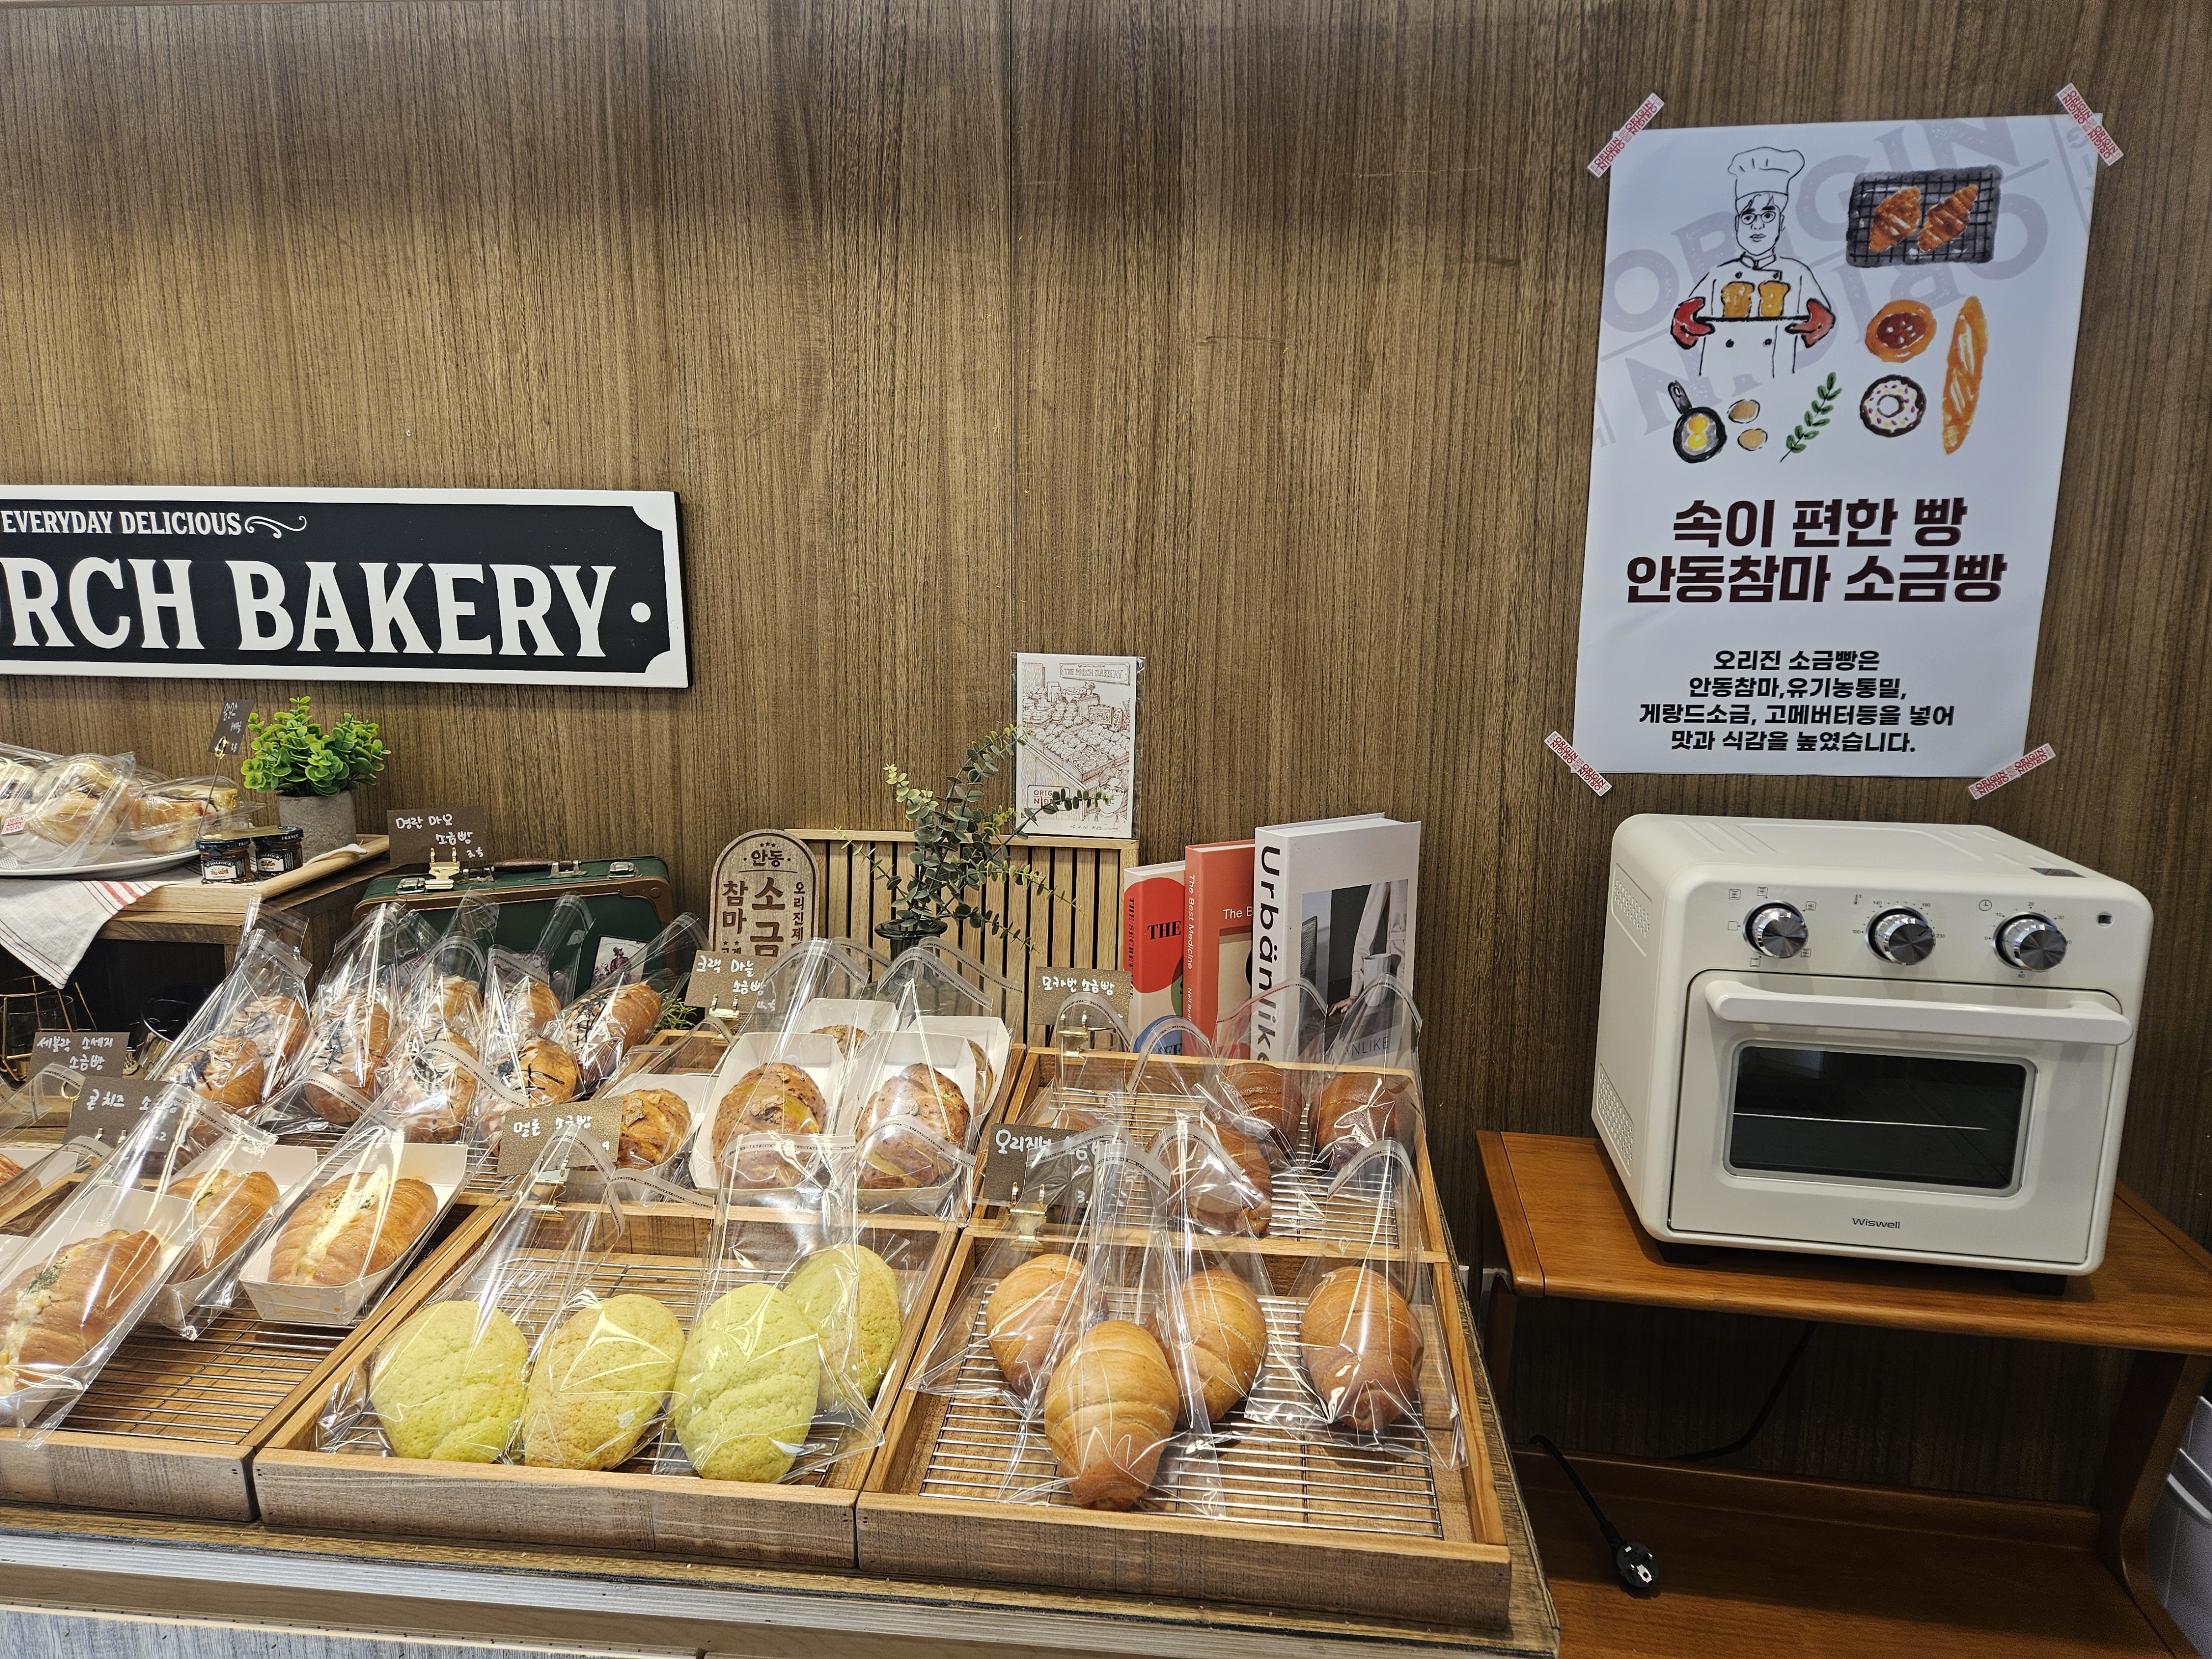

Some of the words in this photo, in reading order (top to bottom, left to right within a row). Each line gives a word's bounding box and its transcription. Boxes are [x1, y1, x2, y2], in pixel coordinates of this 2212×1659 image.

[1625, 100, 1652, 130] ORIGIN
[2070, 91, 2092, 119] ORIGIN
[2095, 126, 2118, 153] ORIGIN
[1594, 137, 1620, 165] ORIGIN
[1, 510, 112, 534] EVERYDAY
[119, 511, 242, 536] DELICIOUS
[1673, 499, 1775, 548] 속이
[1792, 498, 1898, 547] 편한
[1914, 497, 1967, 546] 빵
[1627, 555, 1831, 603] 안동참마
[1844, 554, 2007, 602] 소금빵
[0, 557, 205, 649] RCH
[225, 560, 616, 657] BAKERY
[1714, 650, 1781, 670] 오리진
[1788, 650, 1880, 671] 소금빵은
[1095, 670, 1123, 679] BAKERY
[1639, 703, 1757, 725] 게랑드소금,
[1764, 705, 1901, 725] 고메버터등을
[1909, 705, 1954, 726] 넣어
[1556, 737, 1578, 759] ORIGIN
[1671, 731, 1715, 750] 맛과
[1722, 731, 1788, 751] 식감을
[1796, 732, 1916, 752] 높였습니다.
[1550, 742, 1572, 764] ORIGIN
[2015, 748, 2044, 768] ORIGIN
[1577, 769, 1600, 791] ORIGIN
[1583, 764, 1606, 785] ORIGIN
[1976, 770, 2006, 789] ORIGIN
[396, 816, 423, 829] 명란
[428, 813, 453, 826] 마요
[435, 831, 473, 846] 소금빵
[466, 847, 484, 858] 3.5
[751, 849, 784, 867] 안동
[722, 880, 749, 935] 참마
[791, 881, 806, 948] 오리진제
[1223, 908, 1243, 920] The
[1147, 921, 1182, 940] THE
[731, 958, 754, 978] 마늘
[732, 980, 766, 996] 소금빵
[1082, 978, 1115, 996] 소금빵
[82, 1036, 113, 1050] 소세지
[69, 1053, 105, 1071] 소금빵
[513, 1118, 541, 1138] 멜론
[1852, 1218, 1900, 1229] Wiswell
